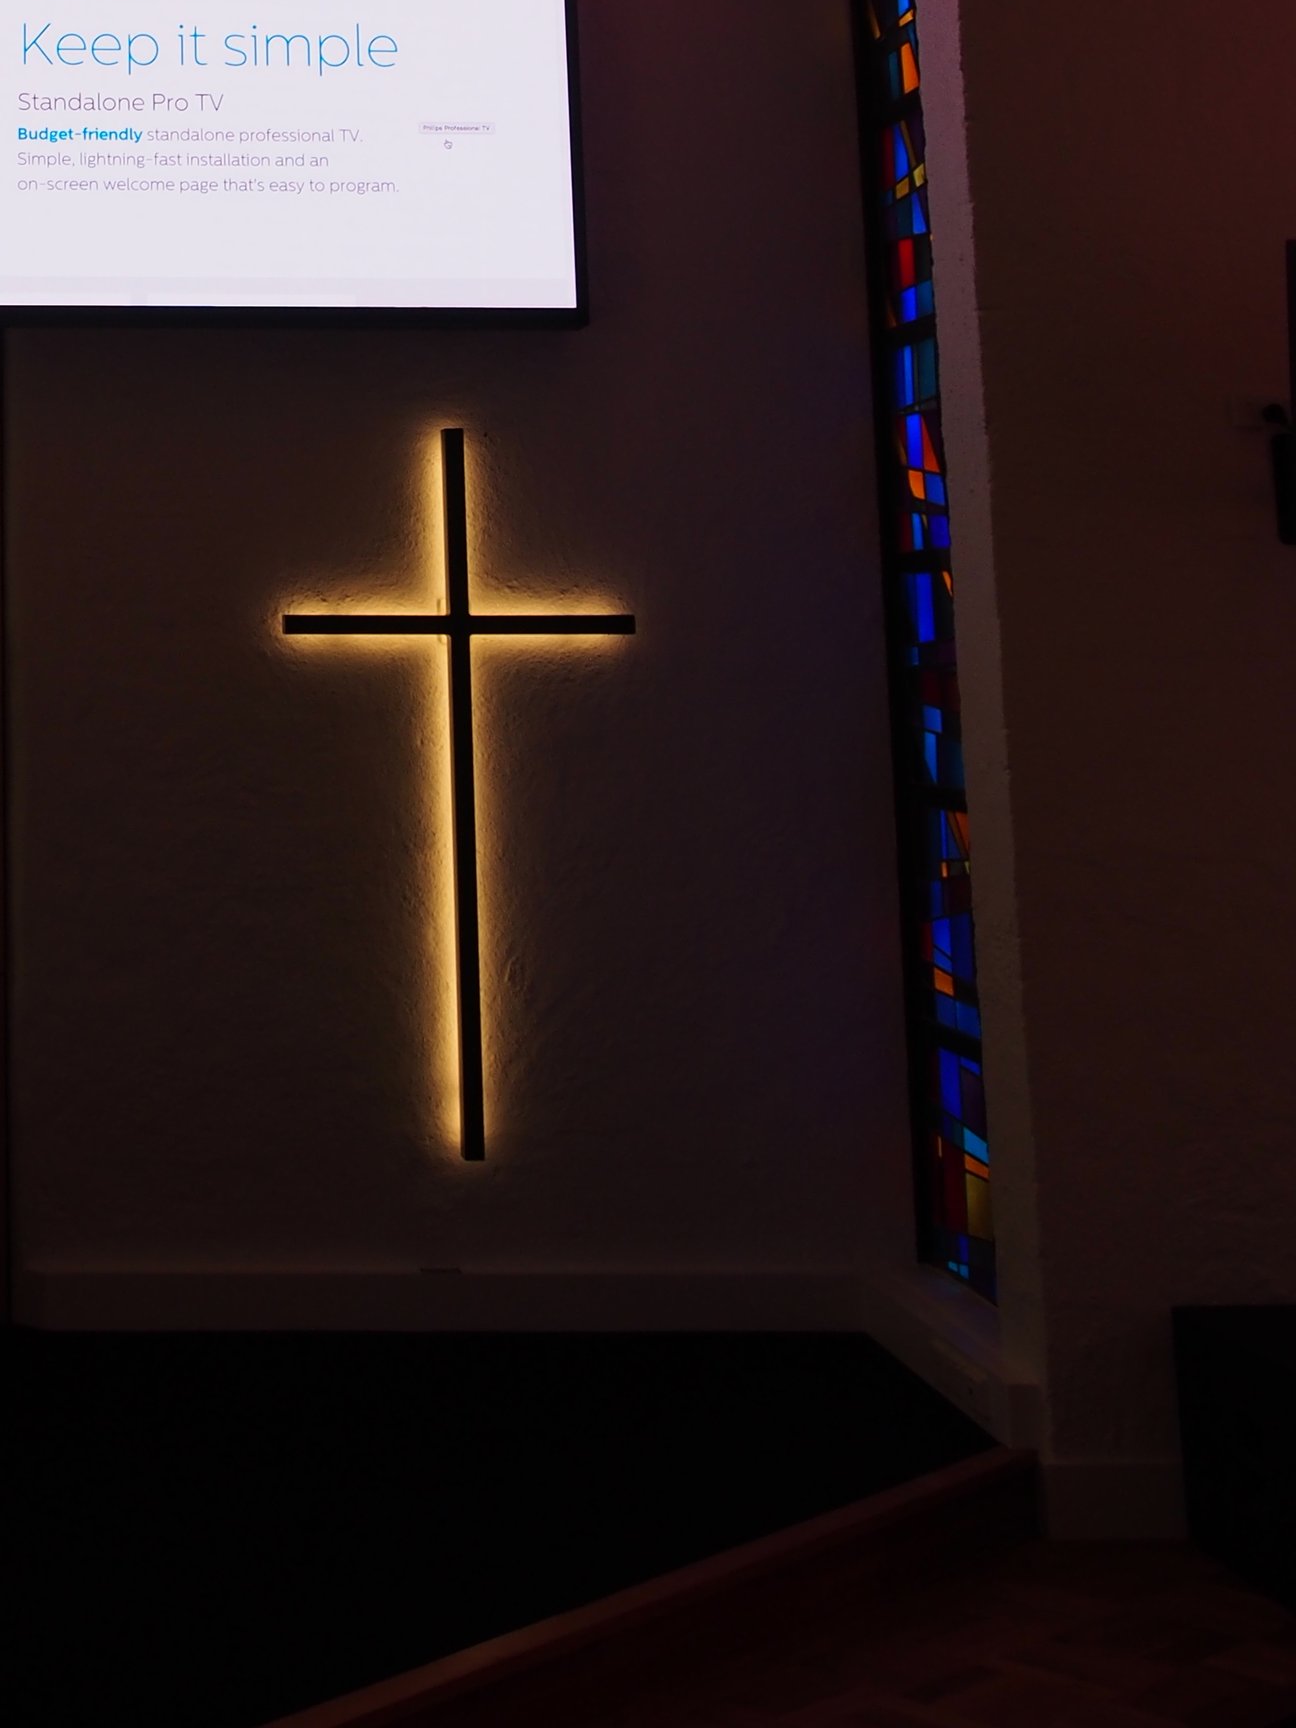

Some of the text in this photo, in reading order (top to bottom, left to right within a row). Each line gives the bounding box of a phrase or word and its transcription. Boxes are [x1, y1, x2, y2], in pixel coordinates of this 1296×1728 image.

[22, 22, 398, 76] Keep it simple
[18, 92, 224, 111] Standalone Pro TV
[17, 127, 363, 144] Budget-friendly standalone professional TV.
[17, 152, 329, 169] Simple, lightning-fast installation and an
[17, 177, 400, 195] on-screen welcome page that's easy to program.
